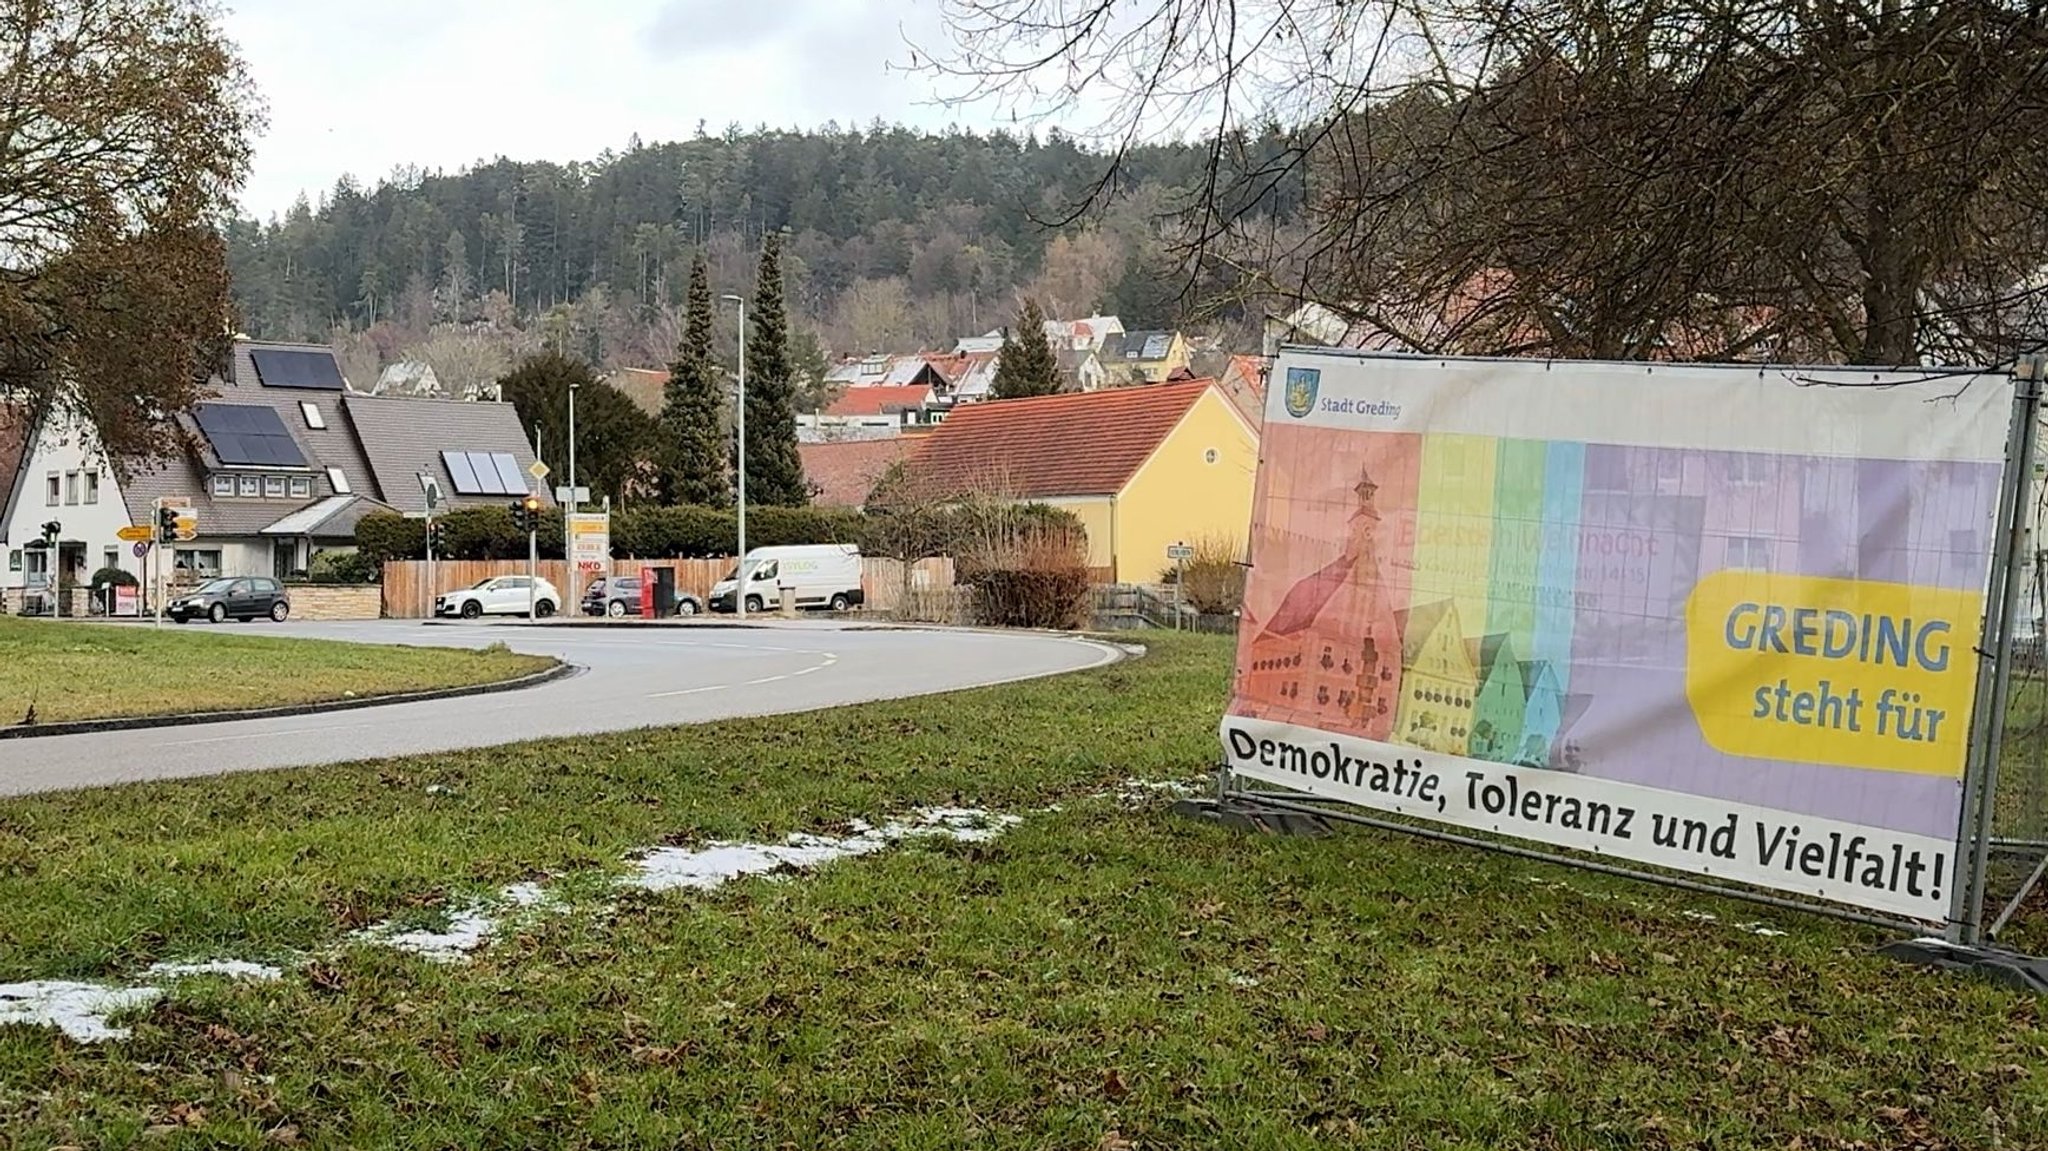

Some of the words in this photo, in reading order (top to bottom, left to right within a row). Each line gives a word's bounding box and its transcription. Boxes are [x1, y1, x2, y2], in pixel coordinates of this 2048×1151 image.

[1321, 397, 1353, 414] Stadt
[1356, 400, 1402, 420] Greding
[577, 561, 601, 571] NKD
[1725, 602, 1951, 672] GREDING
[1753, 679, 1863, 732] steht
[1876, 689, 1946, 742] für
[1229, 728, 1446, 813] Demokratie,
[1465, 771, 1635, 839] Toleranz
[1652, 813, 1738, 859] und
[1756, 822, 1945, 901] Vielfalt!
